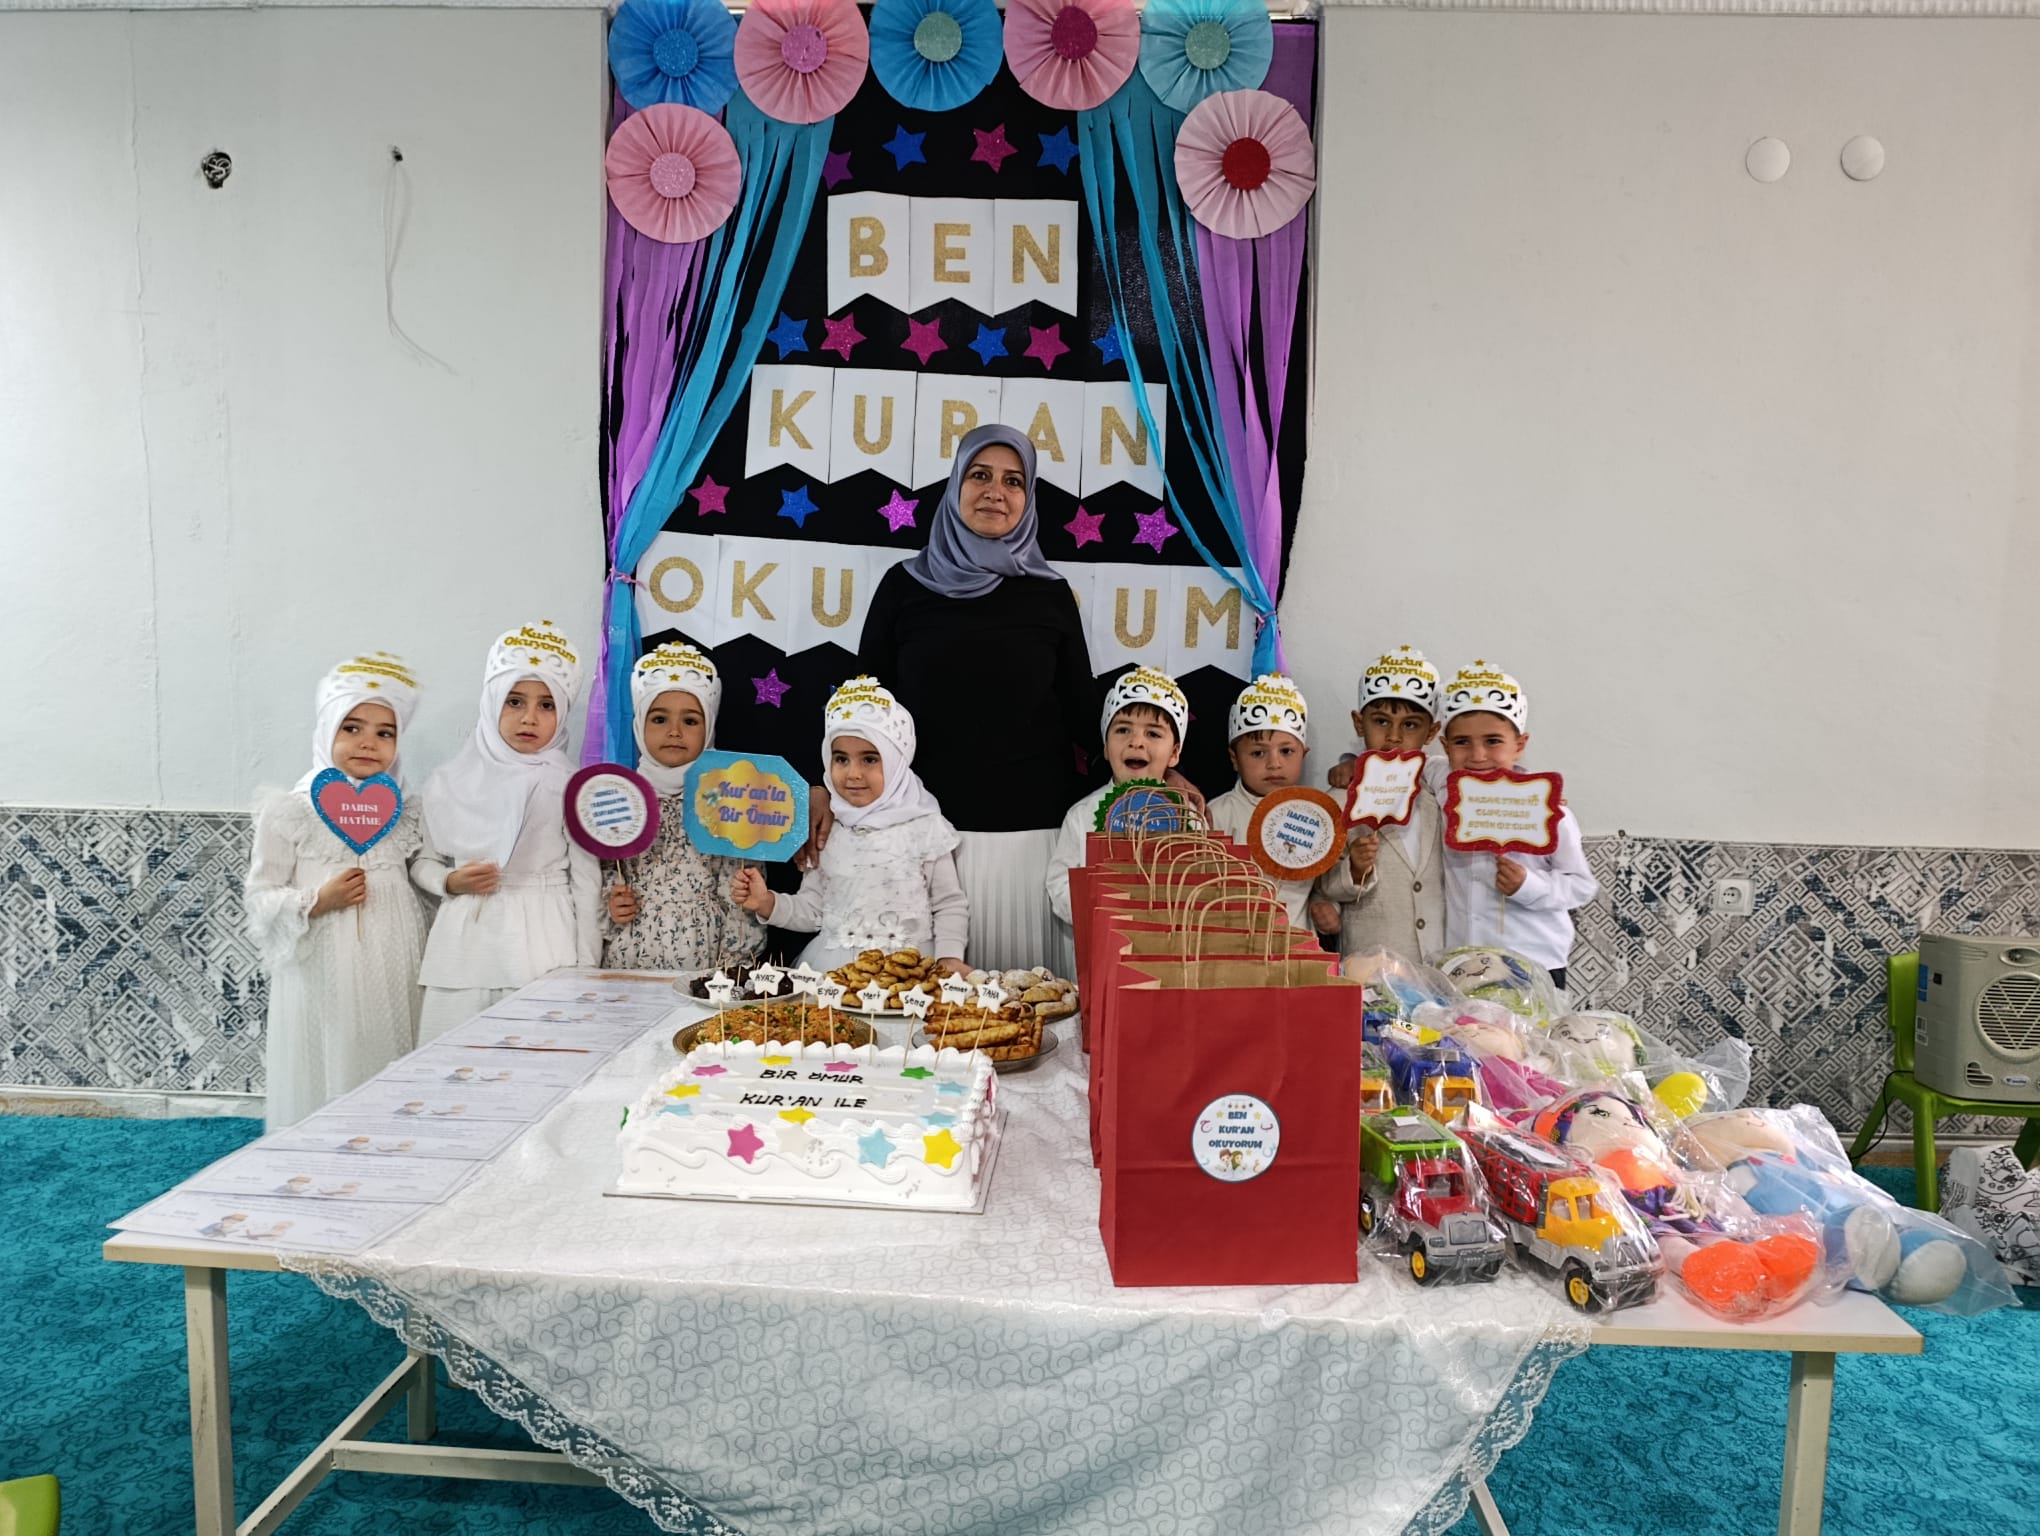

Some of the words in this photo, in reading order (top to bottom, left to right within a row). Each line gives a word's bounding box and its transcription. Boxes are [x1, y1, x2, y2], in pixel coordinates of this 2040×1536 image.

[848, 216, 1061, 284] BEN
[768, 388, 1148, 466] KURAN
[718, 806, 743, 823] Bir
[755, 974, 776, 984] AYAZ
[739, 1093, 822, 1107] KUR'AN
[1228, 1111, 1247, 1120] BEN
[1219, 1125, 1255, 1135] KUR'AN
[1208, 1139, 1263, 1149] OKUYORUM
